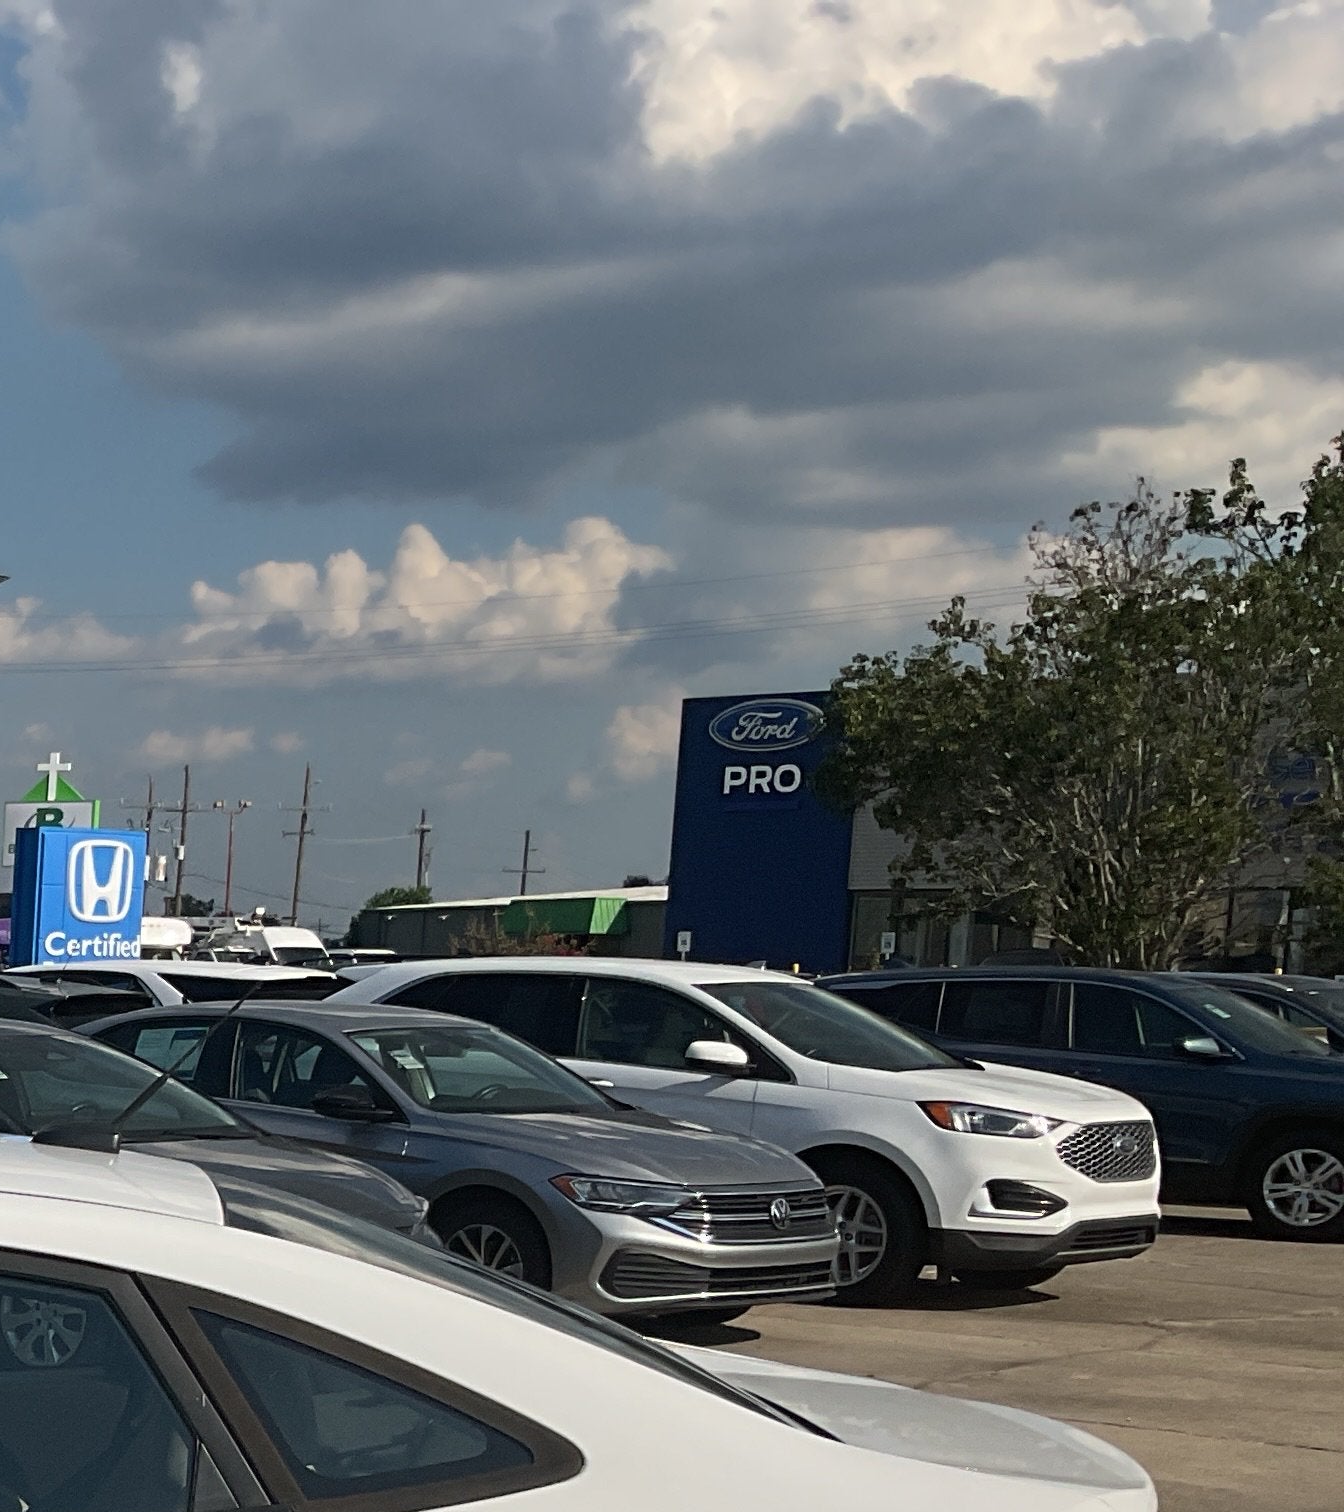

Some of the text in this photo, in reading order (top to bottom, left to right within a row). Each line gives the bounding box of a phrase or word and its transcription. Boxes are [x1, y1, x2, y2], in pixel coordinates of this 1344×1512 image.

[731, 711, 799, 742] Ford
[722, 763, 802, 795] PRO
[44, 931, 141, 959] Certified
